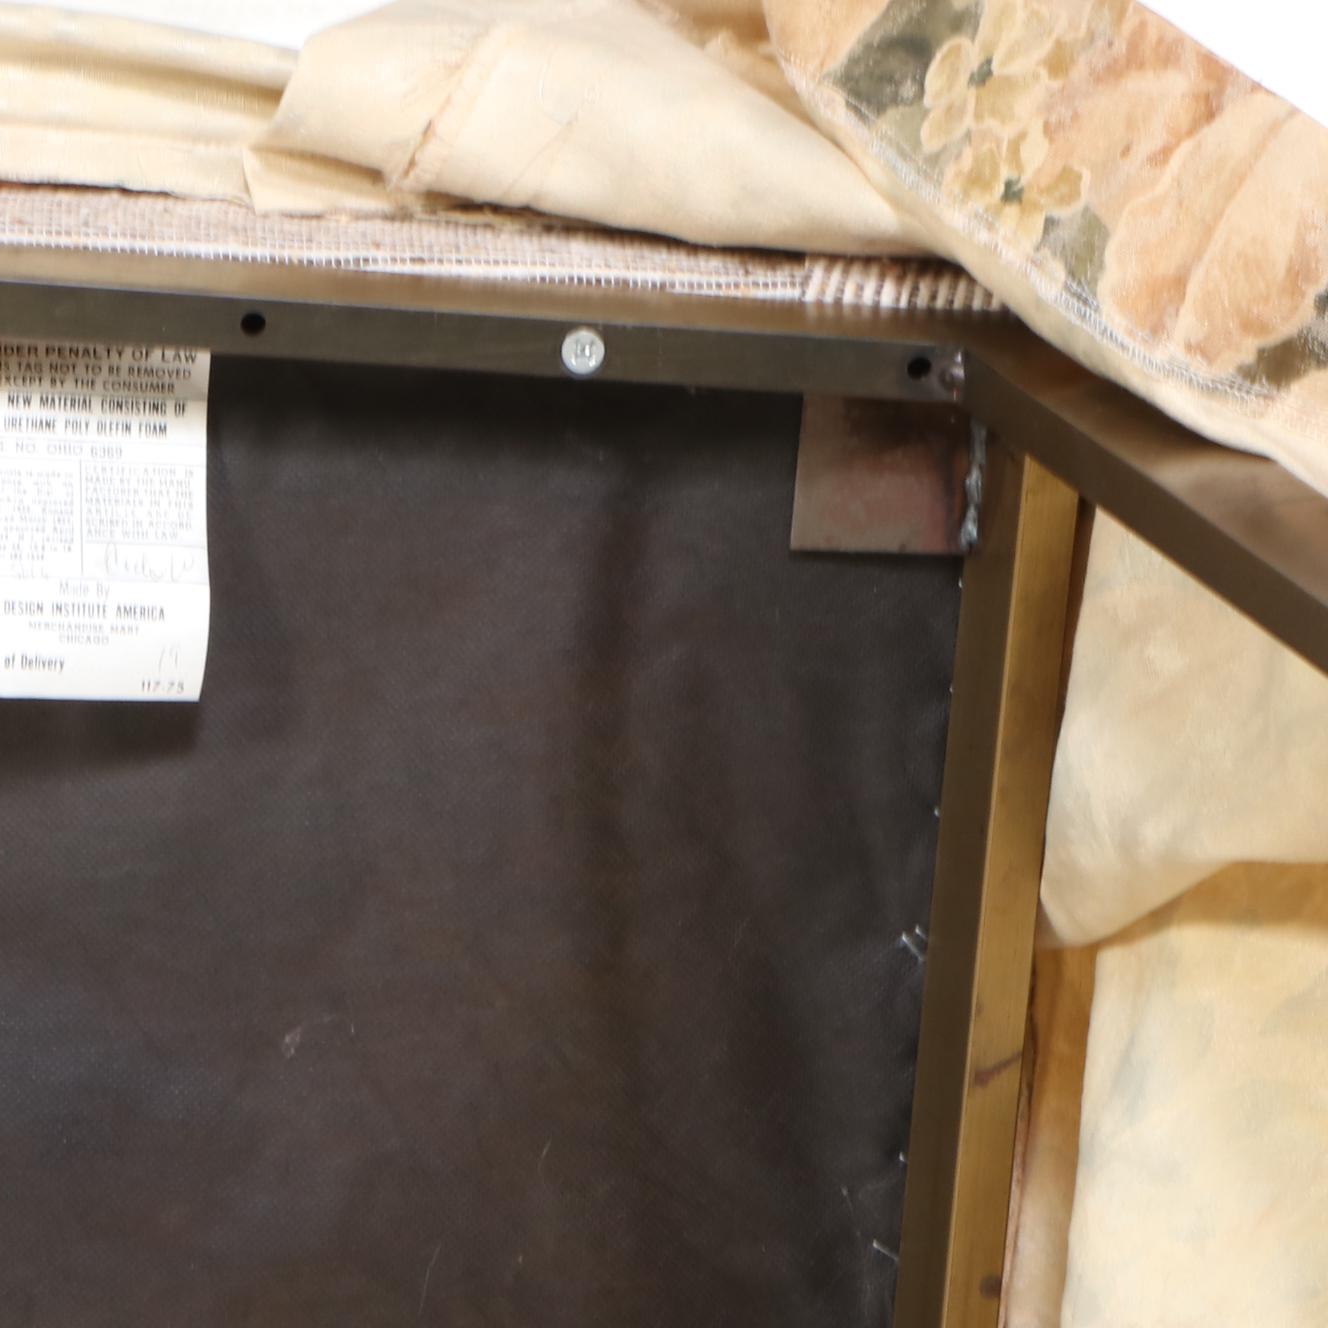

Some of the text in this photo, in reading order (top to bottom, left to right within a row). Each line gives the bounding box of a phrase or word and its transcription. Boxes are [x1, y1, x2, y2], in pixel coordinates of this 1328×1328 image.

[45, 344, 125, 361] PENALTY
[131, 346, 152, 361] OF
[159, 345, 197, 364] LAW
[17, 361, 43, 374] TAG
[49, 362, 77, 374] NOT
[83, 363, 102, 376] TO
[107, 365, 121, 377] BE
[128, 366, 191, 380] REMOVED
[50, 376, 66, 389] BY
[74, 378, 96, 391] THE
[103, 381, 175, 394] CONSUMER
[7, 393, 33, 411] NEW
[39, 394, 93, 414] MATERIAL
[100, 397, 168, 417] CONSISTING
[174, 400, 186, 418] OF
[3, 415, 57, 433] URETHANE
[64, 418, 90, 436] POLY
[138, 422, 168, 439] FOAM
[3, 599, 166, 622] DESIGN INSTITUTE AMERICA
[59, 633, 110, 646] CHICAGO
[4, 652, 16, 670] of
[21, 653, 65, 674] Delivery
